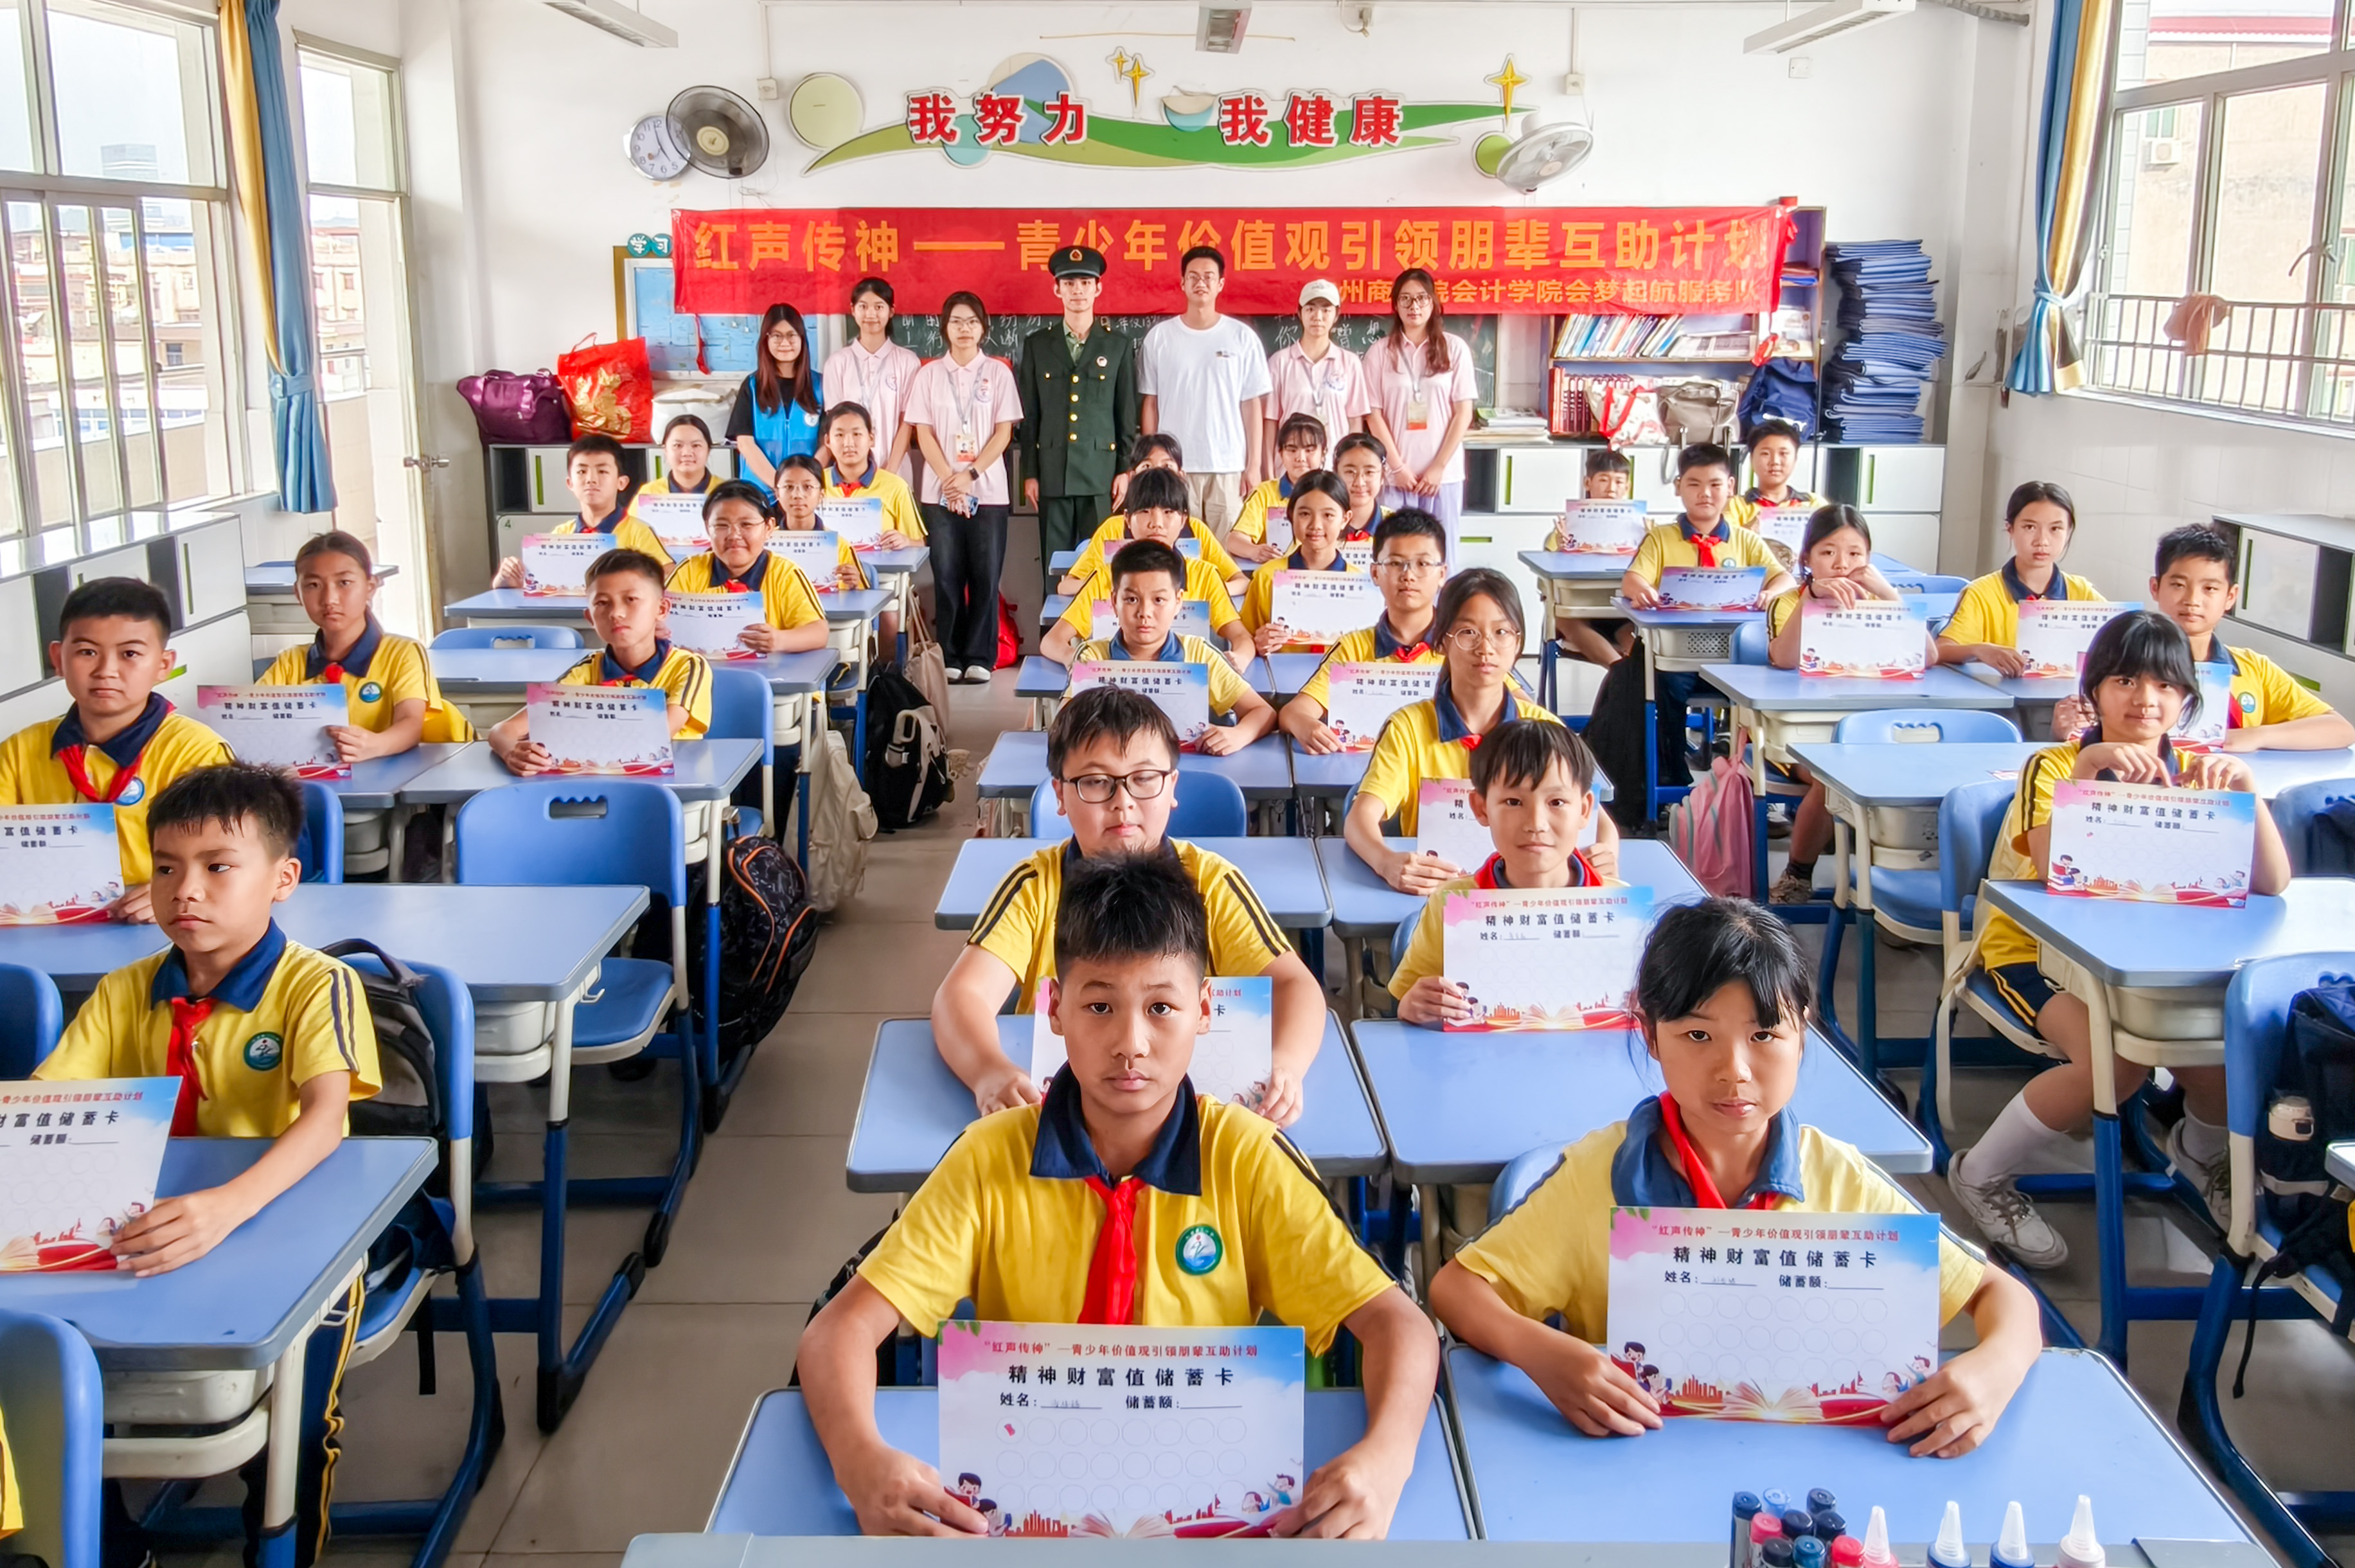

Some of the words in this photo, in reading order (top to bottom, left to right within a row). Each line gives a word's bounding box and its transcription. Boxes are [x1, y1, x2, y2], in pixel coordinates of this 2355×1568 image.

[909, 93, 1084, 143] 我努力
[1220, 94, 1400, 145] 我健康
[632, 235, 669, 253] 学习
[1340, 279, 1759, 303] 州商院会计学院会梦起航服务队
[2092, 802, 2215, 821] 精神财富值储蓄卡
[1486, 912, 1615, 927] 精神财富值储蓄卡
[1214, 1004, 1225, 1017] 卡
[1673, 1246, 1876, 1268] 精神财富值储蓄卡
[1664, 1270, 1698, 1284] 姓名：
[1779, 1274, 1827, 1288] 储蓄额：
[1008, 1364, 1233, 1386] 精神财富值储蓄卡
[1000, 1392, 1036, 1407] 姓名：
[1126, 1395, 1180, 1409] 储蓄额：
